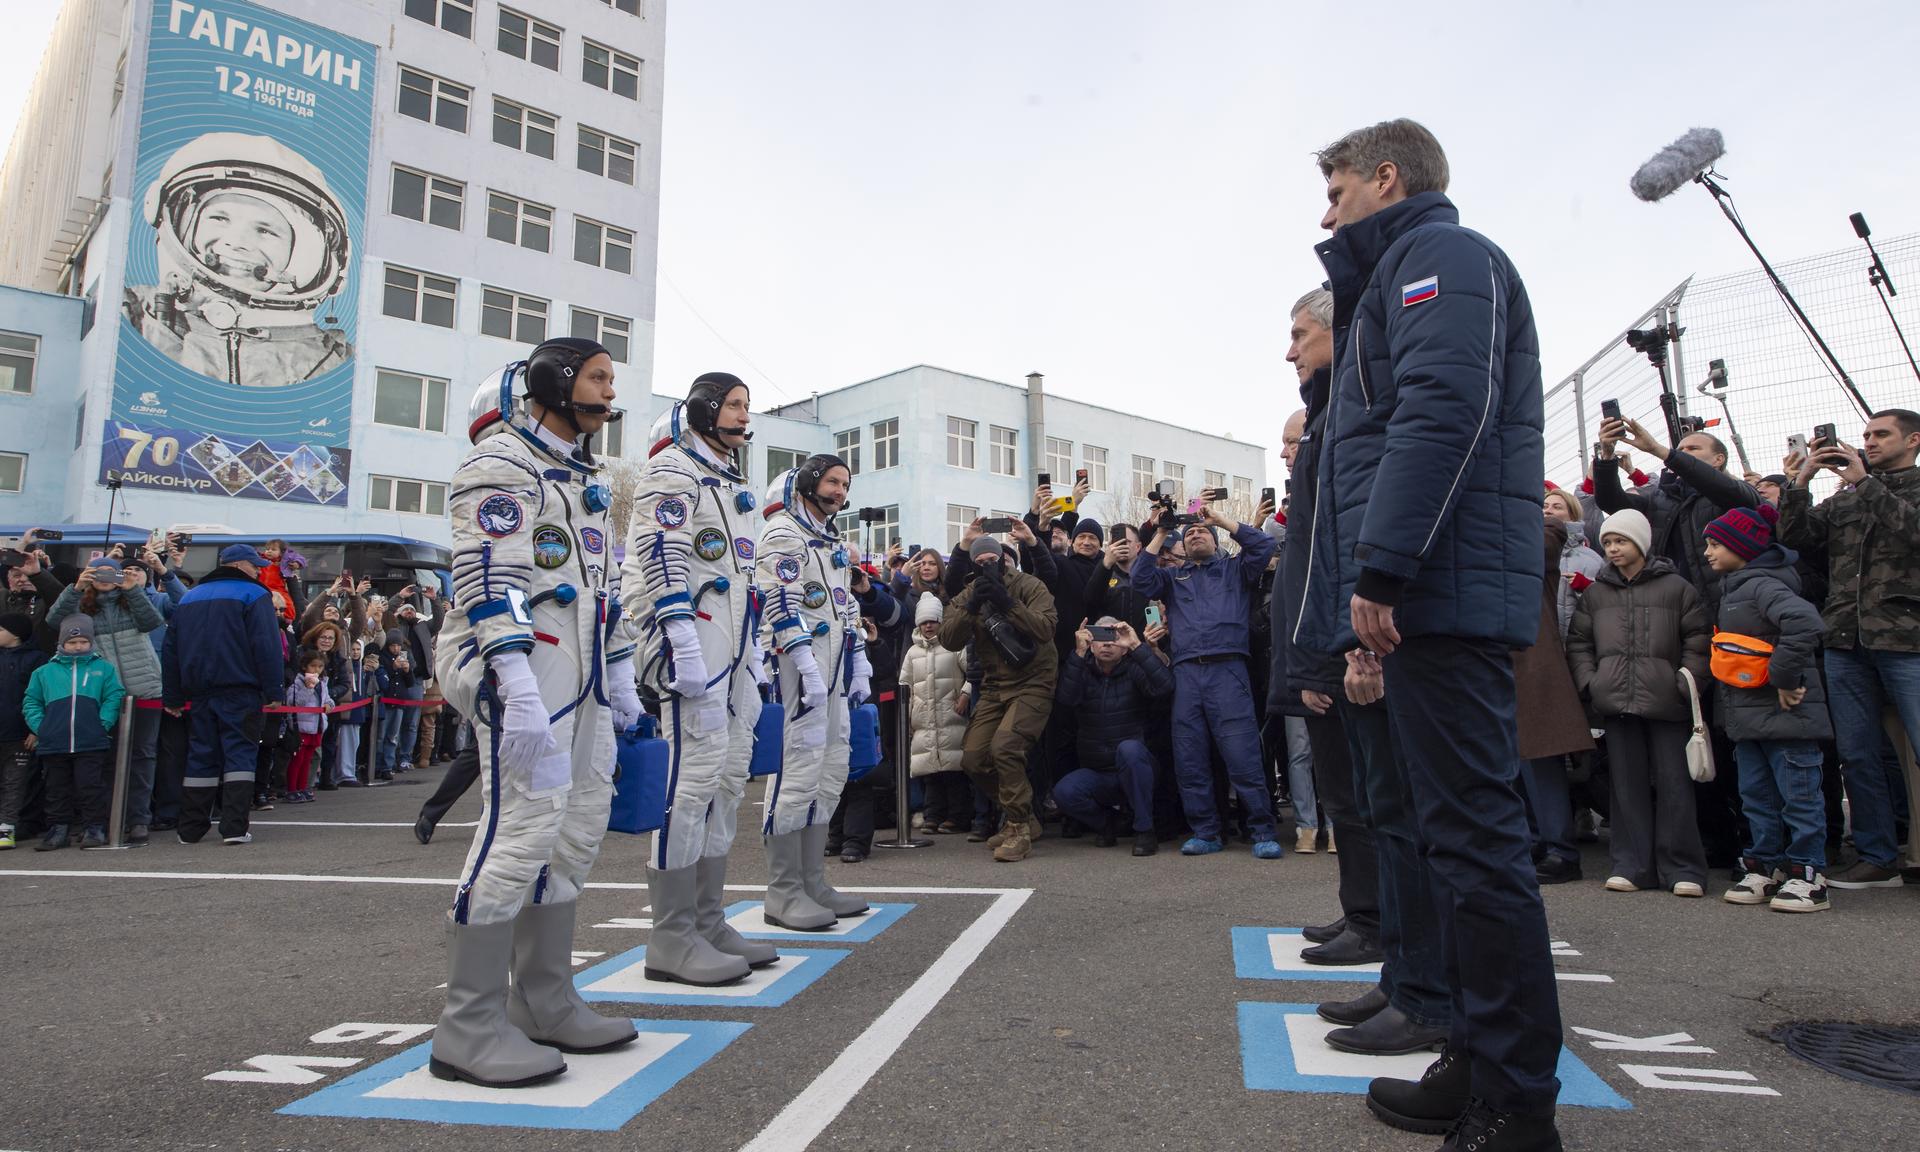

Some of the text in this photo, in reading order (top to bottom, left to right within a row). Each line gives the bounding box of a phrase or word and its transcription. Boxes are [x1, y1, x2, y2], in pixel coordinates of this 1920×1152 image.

[169, 0, 361, 91] ГАГАРИН
[215, 66, 316, 107] 12 АПРЕЛЯ
[254, 91, 314, 118] 1961 года
[119, 428, 179, 469] 70
